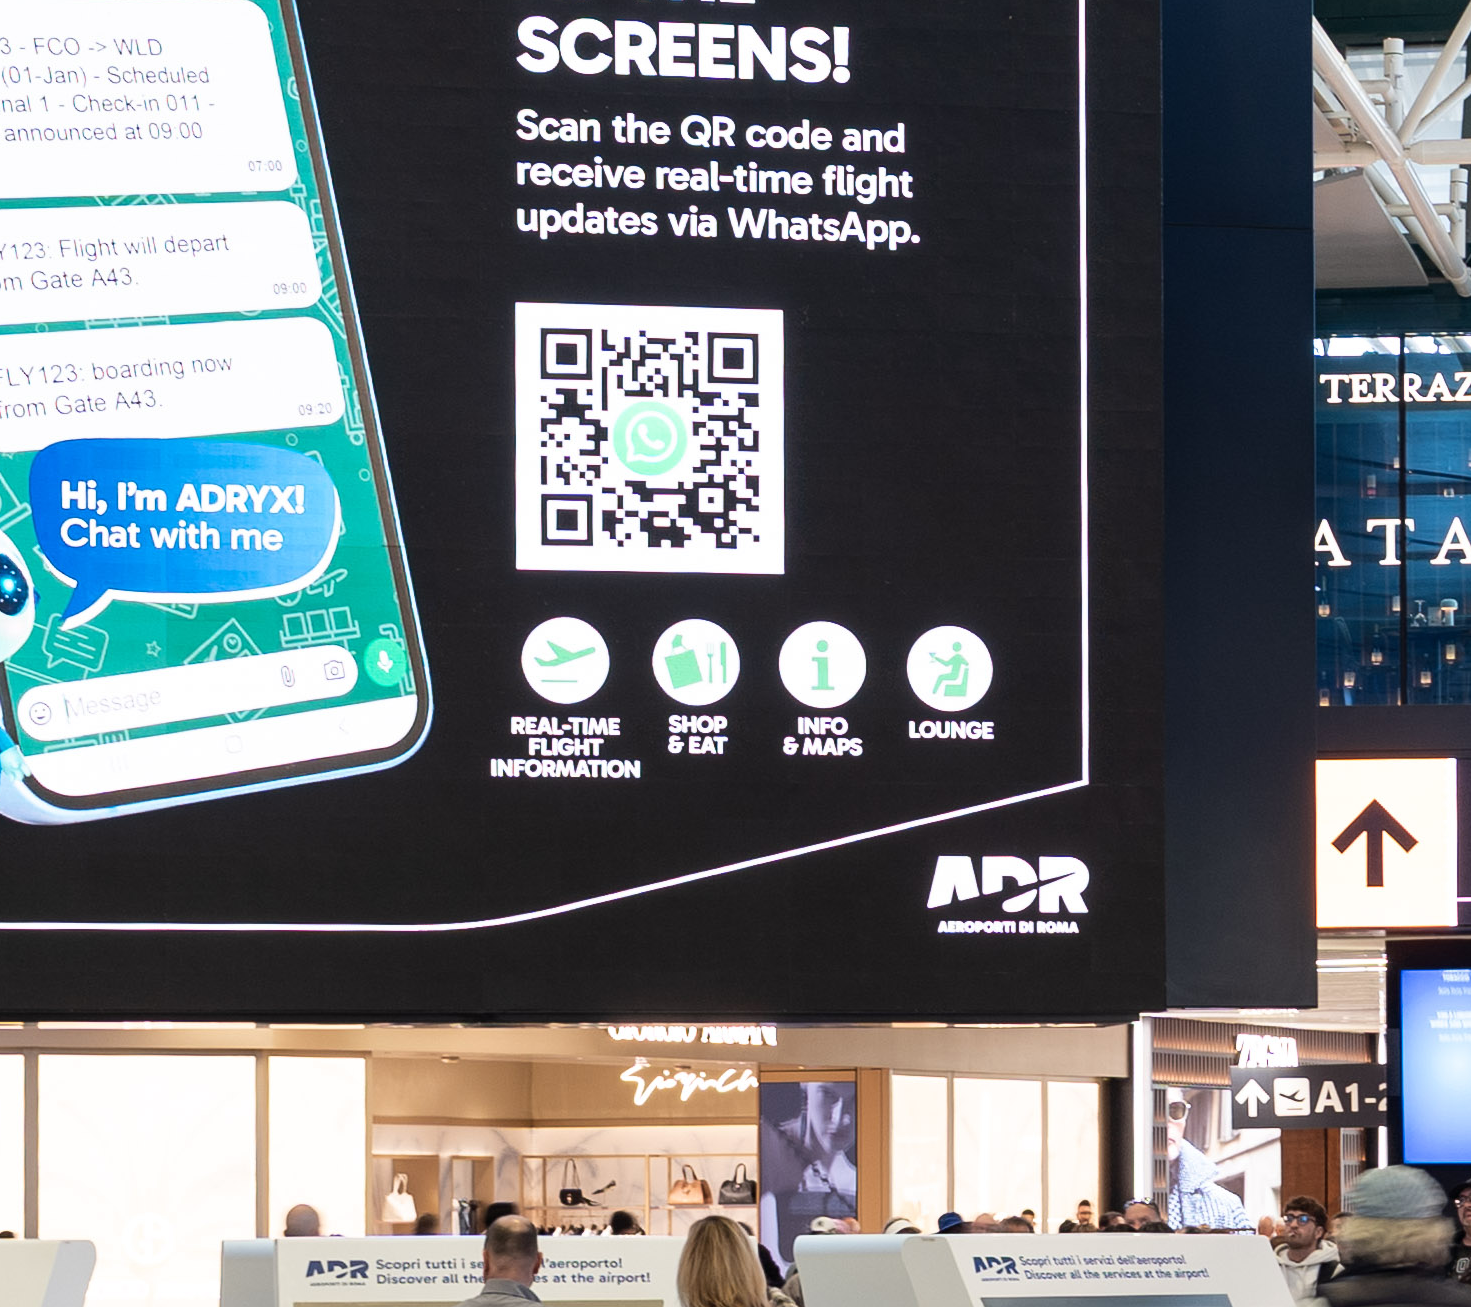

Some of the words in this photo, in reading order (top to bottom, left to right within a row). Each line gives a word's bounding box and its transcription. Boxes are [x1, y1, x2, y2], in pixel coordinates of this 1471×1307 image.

[33, 37, 81, 57] FCO
[114, 37, 163, 57] WLD
[515, 15, 852, 84] SCREENS!
[1, 65, 87, 88] (01-Jan)
[107, 65, 211, 86] Scheduled
[40, 95, 50, 114] 1
[71, 94, 161, 115] Check-in
[166, 94, 201, 113] 011
[3, 122, 117, 144] announced
[124, 123, 144, 141] at
[147, 122, 204, 140] 09:00
[516, 109, 601, 143] Scan
[612, 113, 671, 144] the
[681, 115, 736, 150] QR
[745, 119, 832, 150] code
[842, 122, 906, 153] and
[248, 160, 283, 173] 07:00
[516, 156, 646, 190] receive
[655, 161, 814, 195] real-time
[821, 165, 914, 204] flight
[516, 203, 658, 240] updates
[667, 206, 718, 238] via
[727, 207, 921, 251] WhatsApp.
[59, 237, 117, 263] Flight
[124, 235, 159, 256] will
[165, 233, 230, 259] depart
[31, 268, 83, 292] Gate
[91, 266, 140, 289] A43.
[273, 281, 307, 296] 09:00
[92, 358, 185, 384] boarding
[191, 355, 233, 375] now
[55, 393, 107, 416] Gate
[115, 389, 164, 412] A43.
[298, 402, 333, 417] 09:20
[61, 480, 107, 516] Hi,
[117, 481, 169, 513] I'm
[175, 483, 306, 515] ADRYX!
[60, 517, 141, 549] Chat
[150, 519, 221, 550] with
[230, 525, 284, 551] me
[69, 688, 162, 723] Message
[510, 716, 621, 737] REAL-TIME
[667, 715, 728, 735] SHOP
[797, 716, 849, 736] INFO
[908, 720, 996, 741] LOUNGE
[528, 737, 604, 758] FLIGHT
[667, 735, 684, 756] &
[687, 736, 729, 756] EAT
[782, 737, 798, 757] &
[801, 737, 864, 758] MAPS
[490, 758, 641, 780] INFORMATION
[926, 855, 1090, 914] ADR
[937, 920, 1017, 934] AEROPORTI
[1019, 921, 1034, 934] DI
[1036, 921, 1080, 934] ROMA
[305, 1260, 370, 1280] ADR
[376, 1259, 421, 1272] Scopri
[425, 1258, 457, 1270] tutti
[972, 1256, 1020, 1275] ADR
[1019, 1255, 1051, 1269] Scopri
[1053, 1255, 1076, 1266] tutti
[1083, 1255, 1115, 1266] servizi
[376, 1272, 438, 1285] Discover
[442, 1273, 459, 1284] all
[463, 1273, 484, 1284] the
[1024, 1269, 1067, 1281] Discover
[1070, 1269, 1081, 1280] all
[1083, 1269, 1100, 1280] the
[1102, 1269, 1142, 1280] services
[1144, 1269, 1155, 1280] at
[1157, 1268, 1174, 1280] the
[1177, 1268, 1210, 1280] airport!
